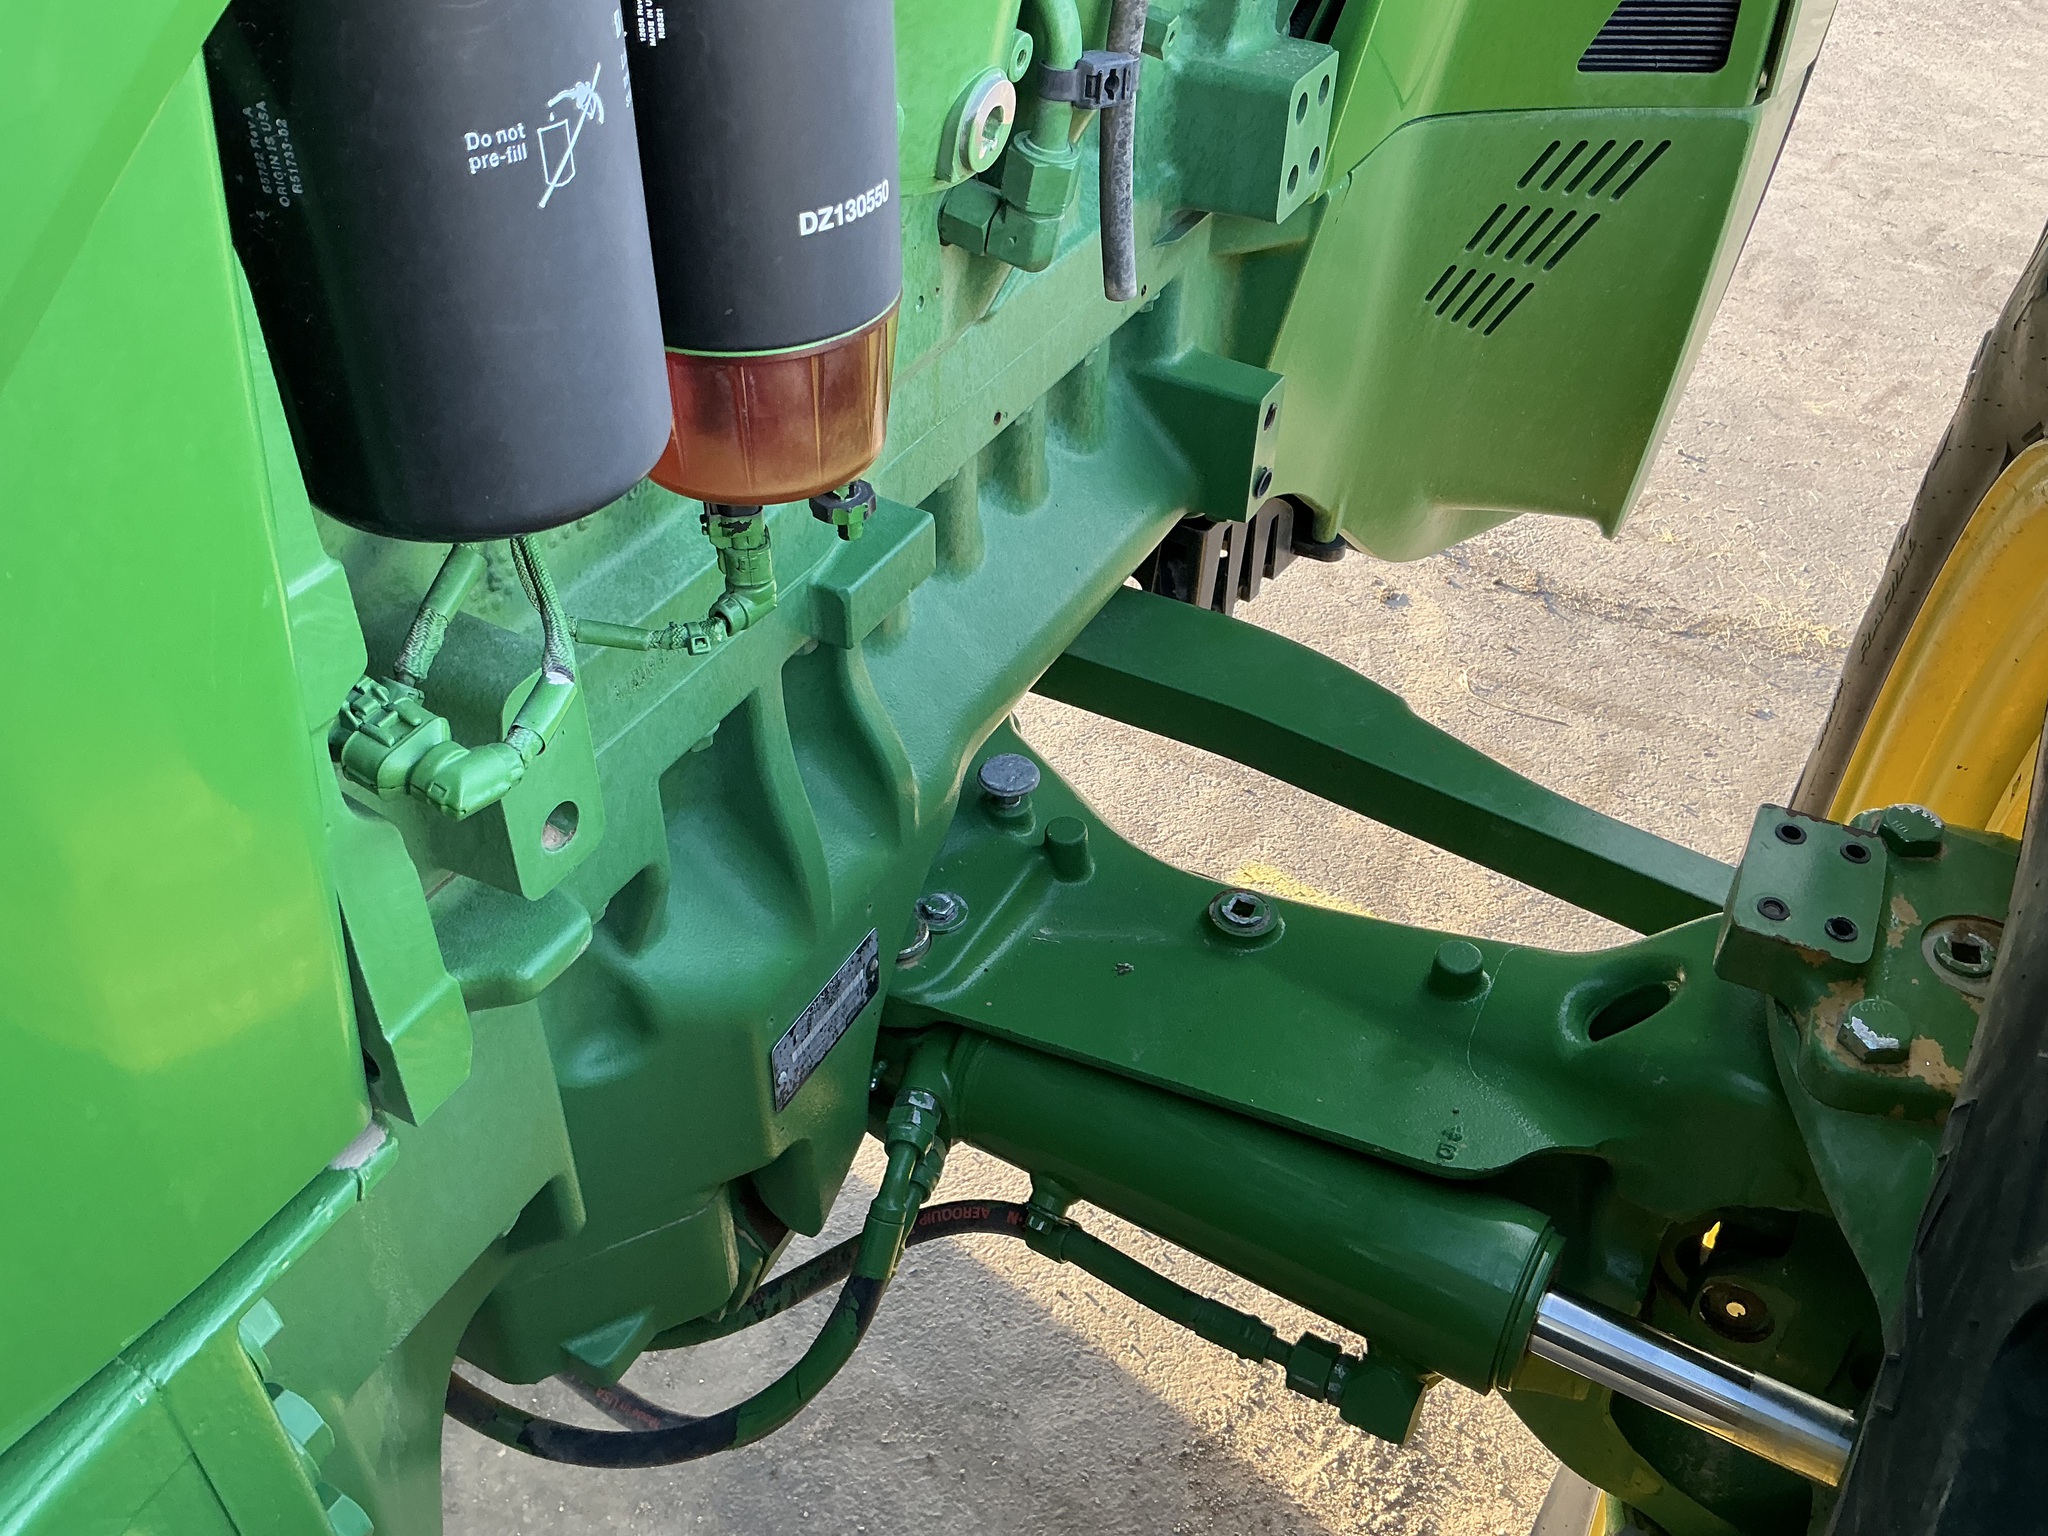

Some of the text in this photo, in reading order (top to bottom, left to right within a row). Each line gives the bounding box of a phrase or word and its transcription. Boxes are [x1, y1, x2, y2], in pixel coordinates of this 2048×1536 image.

[646, 8, 654, 19] IN
[647, 20, 657, 47] MADE
[242, 106, 254, 118] A
[248, 121, 261, 149] Rev
[464, 122, 526, 151] Do not
[256, 101, 290, 207] ORIGIN IS USA
[468, 142, 528, 175] pre-fill
[799, 178, 889, 236] DZ130550
[919, 1206, 992, 1226] AEROQUIP
